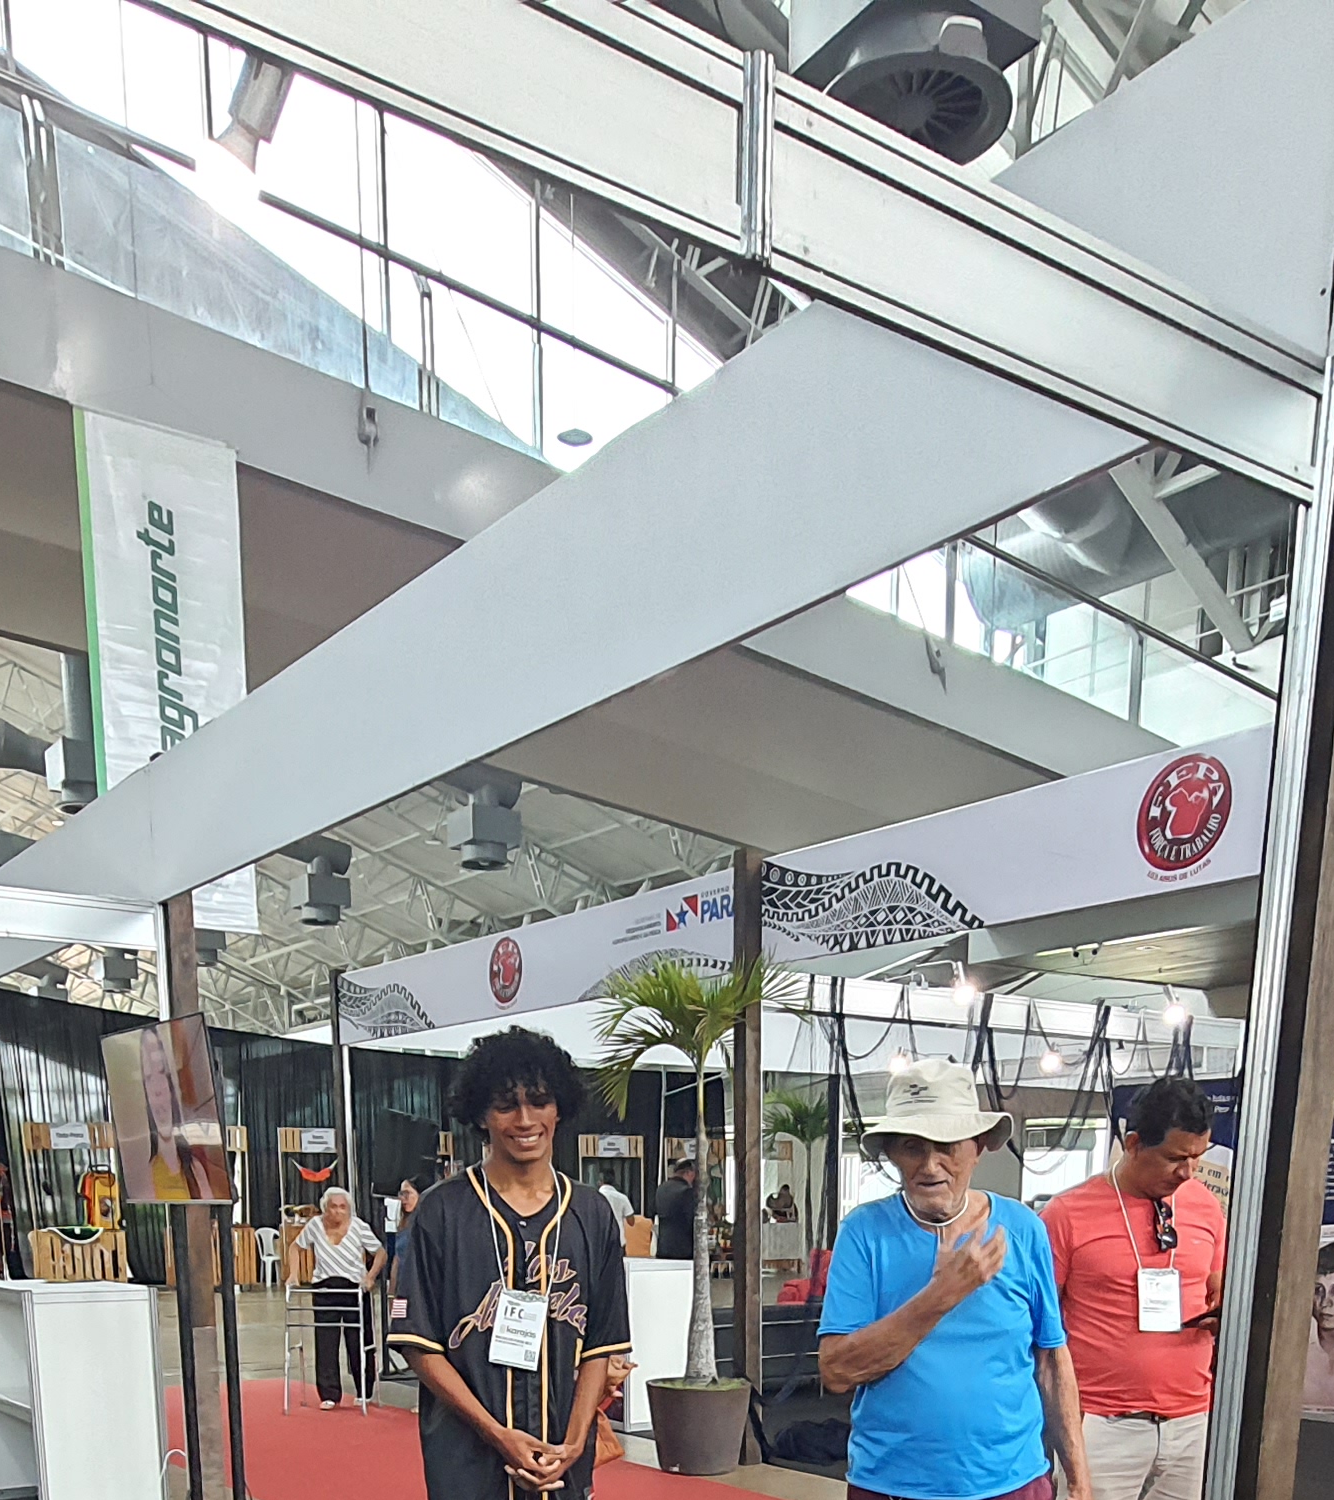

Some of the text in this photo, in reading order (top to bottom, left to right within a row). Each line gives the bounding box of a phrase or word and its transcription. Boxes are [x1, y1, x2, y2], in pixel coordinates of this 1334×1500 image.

[1148, 761, 1225, 821] FEPA
[1149, 813, 1222, 861] FORÇA E TRABALHO
[1190, 858, 1212, 877] LUTAS
[700, 894, 734, 924] PAR
[504, 1305, 524, 1320] IFC
